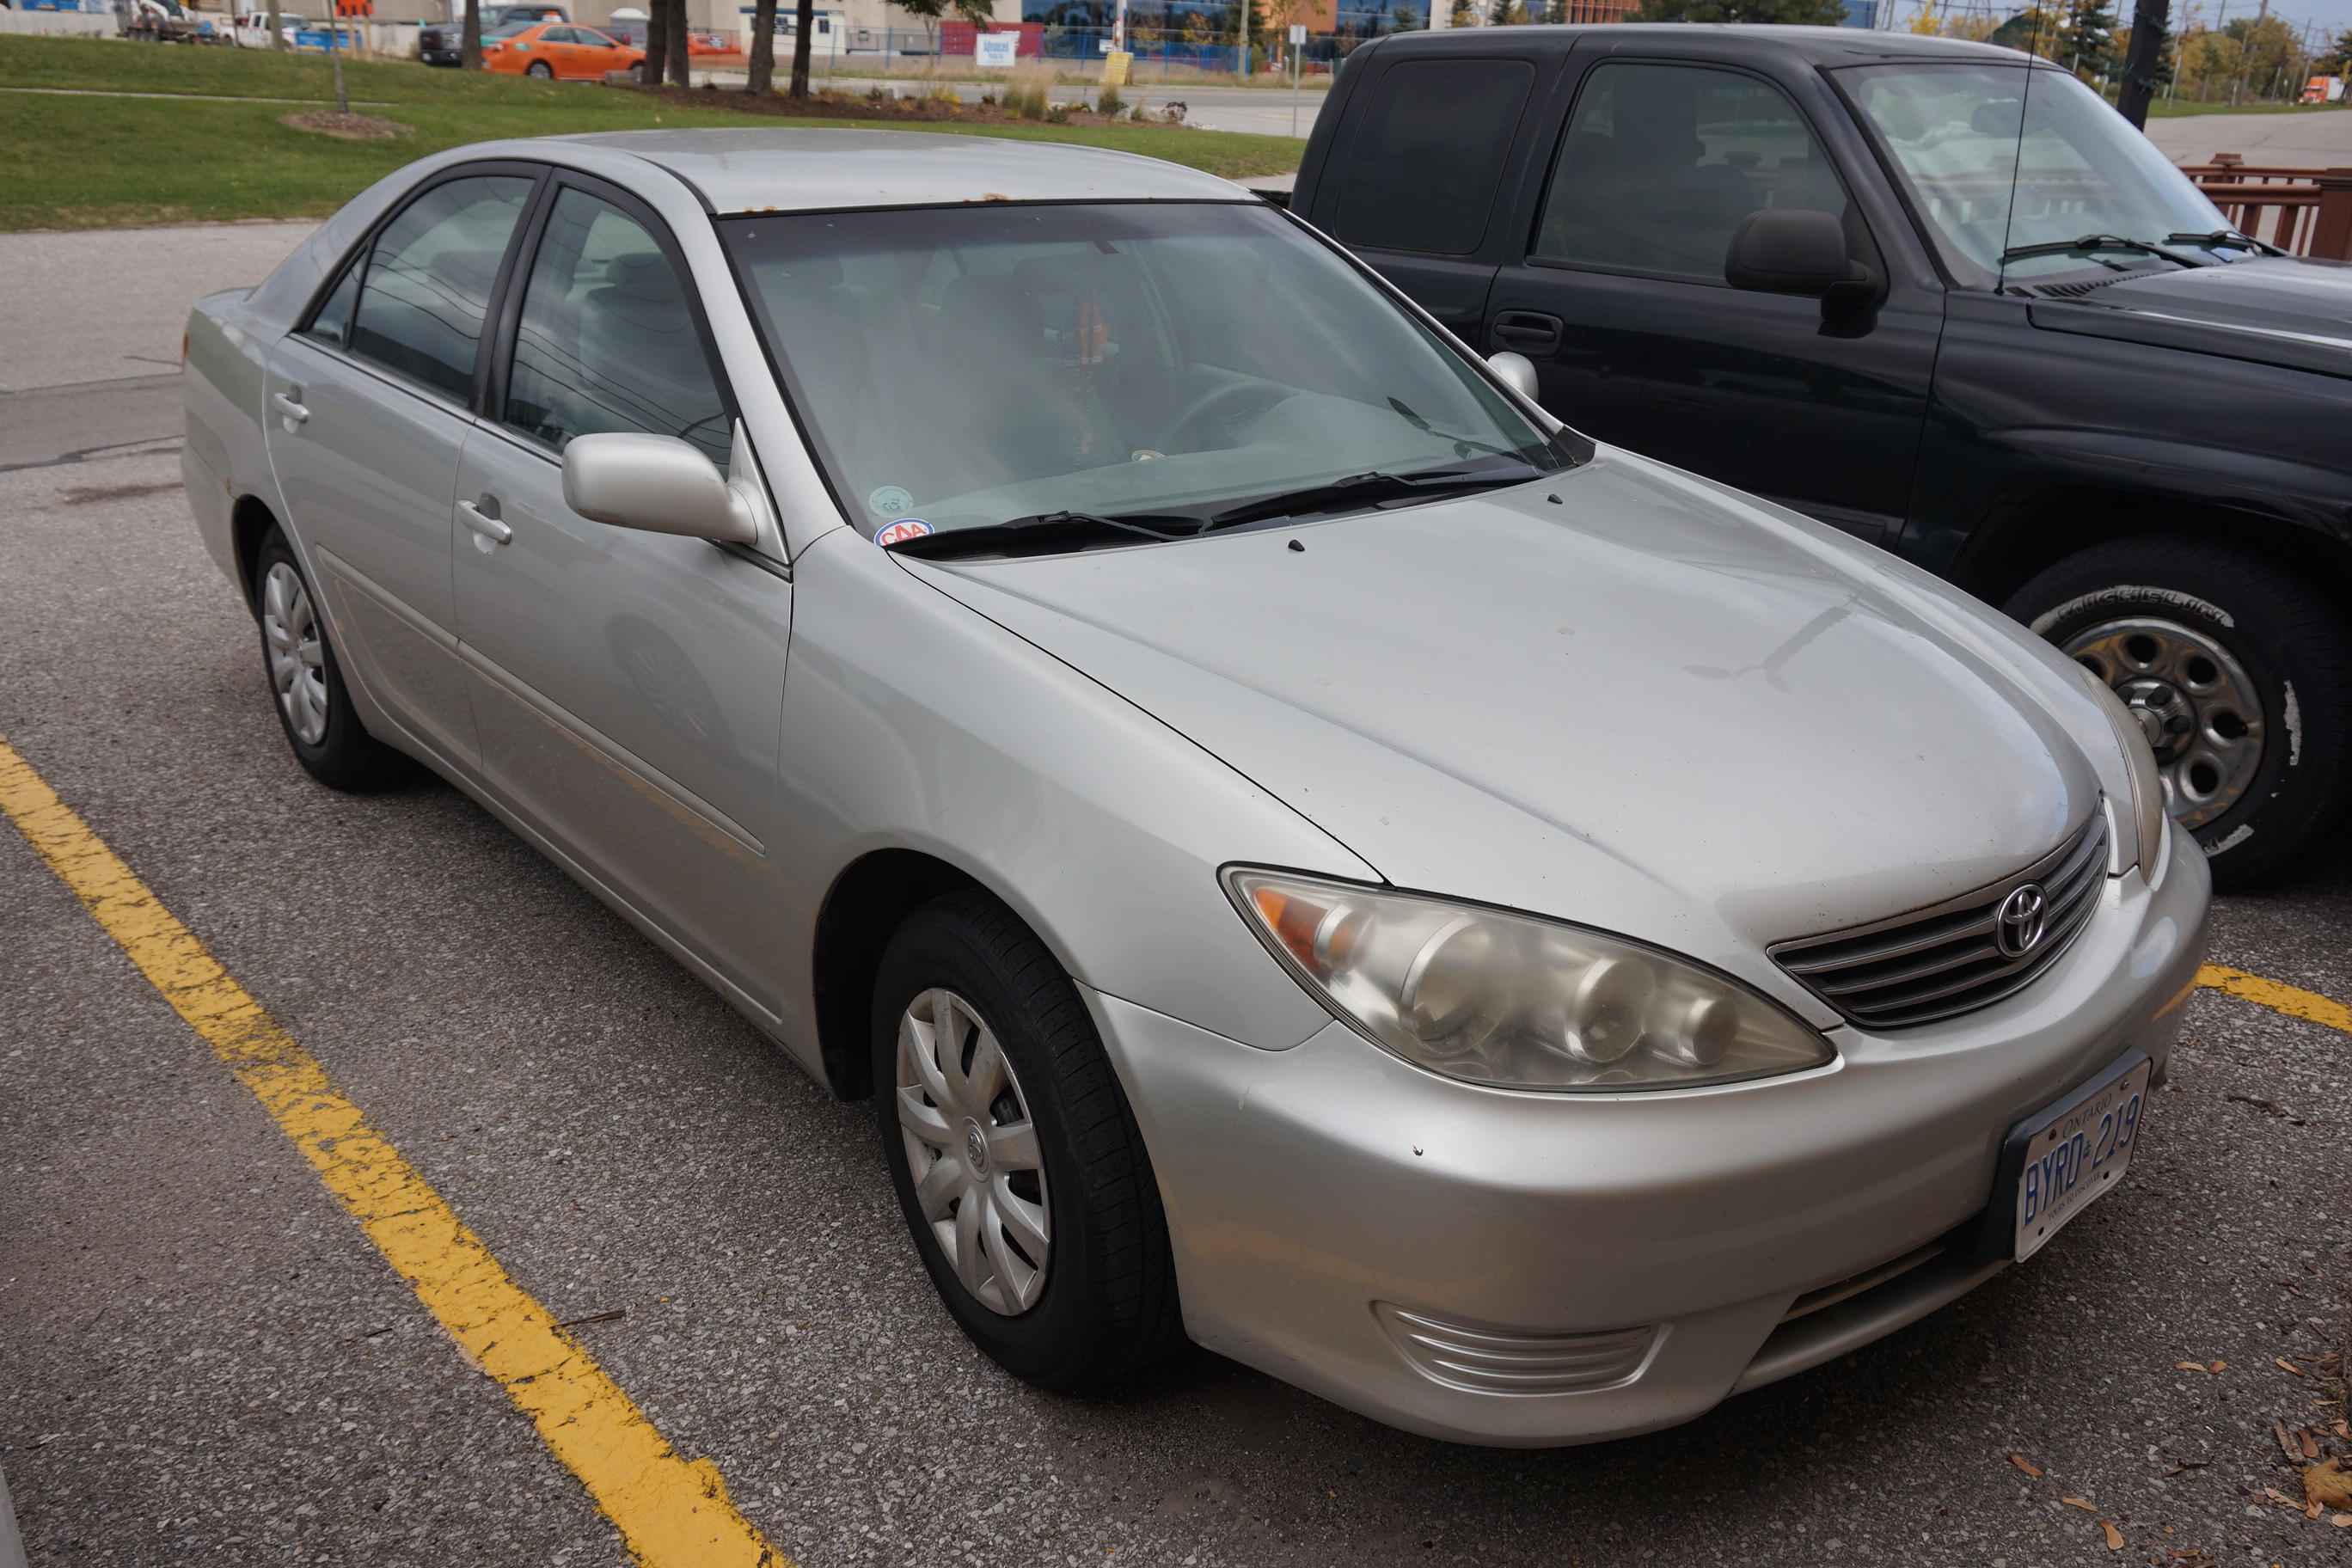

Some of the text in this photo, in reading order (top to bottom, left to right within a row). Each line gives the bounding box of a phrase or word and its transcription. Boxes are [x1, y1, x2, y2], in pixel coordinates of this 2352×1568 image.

[983, 40, 1009, 52] Advanced
[881, 524, 927, 545] CAA
[2056, 588, 2224, 623] MICHELIN
[2062, 1093, 2112, 1139] ONTARIO
[2024, 1094, 2140, 1227] BYRD 219
[2048, 1171, 2100, 1221] YOURS TO DISCOVER
